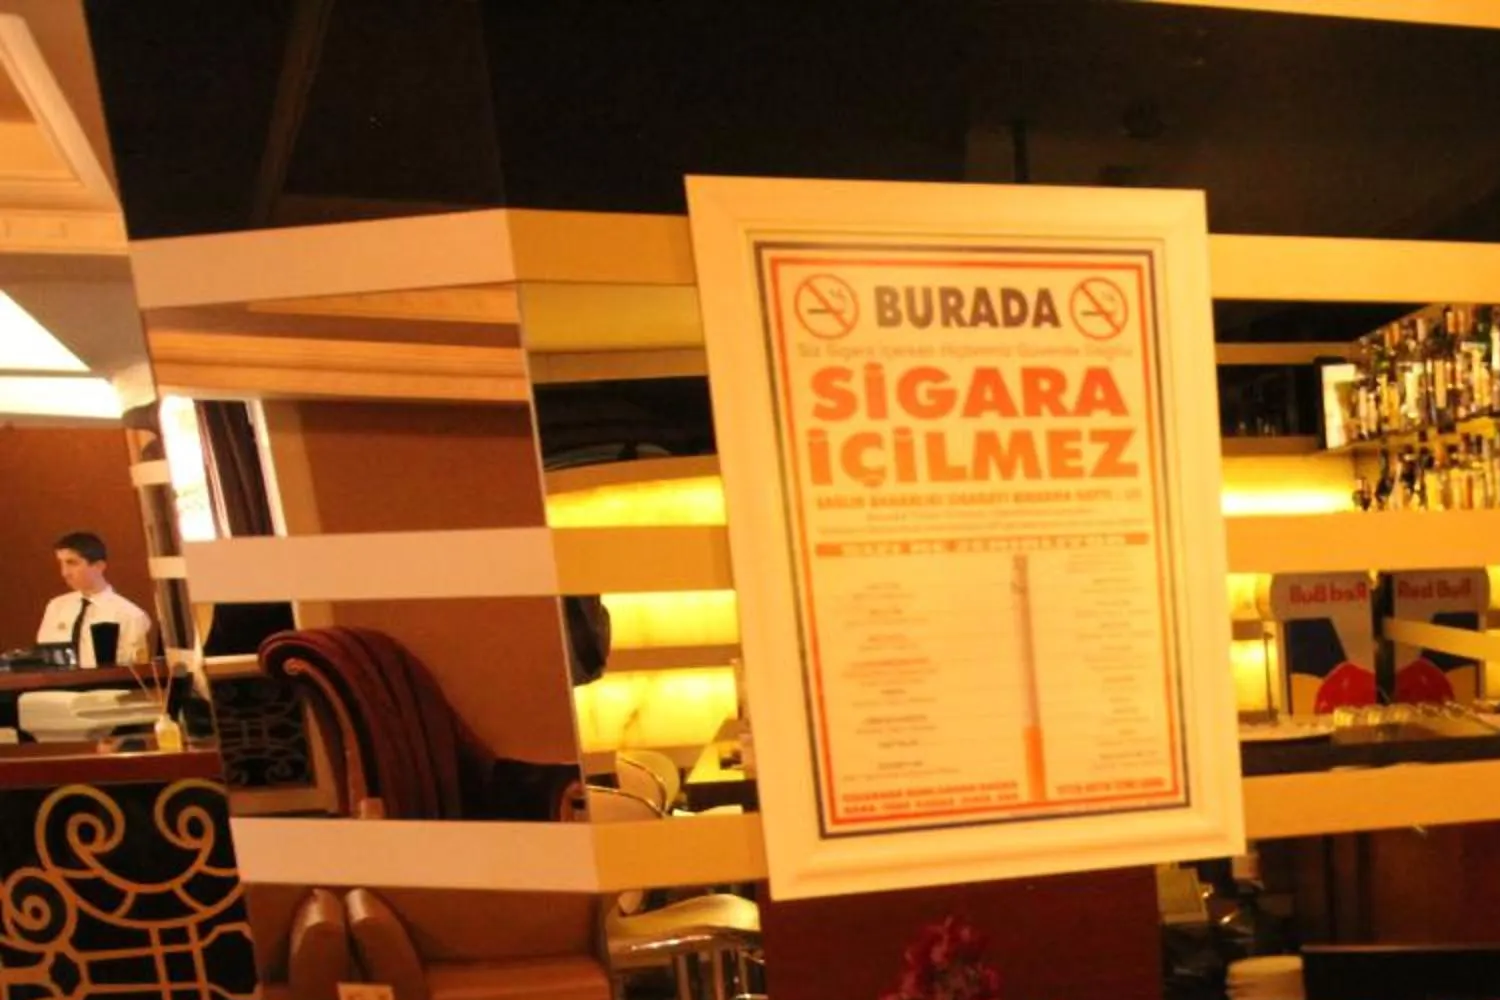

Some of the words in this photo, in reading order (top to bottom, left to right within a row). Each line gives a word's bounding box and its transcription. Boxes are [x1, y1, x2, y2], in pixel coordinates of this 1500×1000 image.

[873, 285, 1062, 329] BURADA
[809, 363, 1130, 422] SİGARA
[806, 426, 1140, 487] İÇİLMEZ
